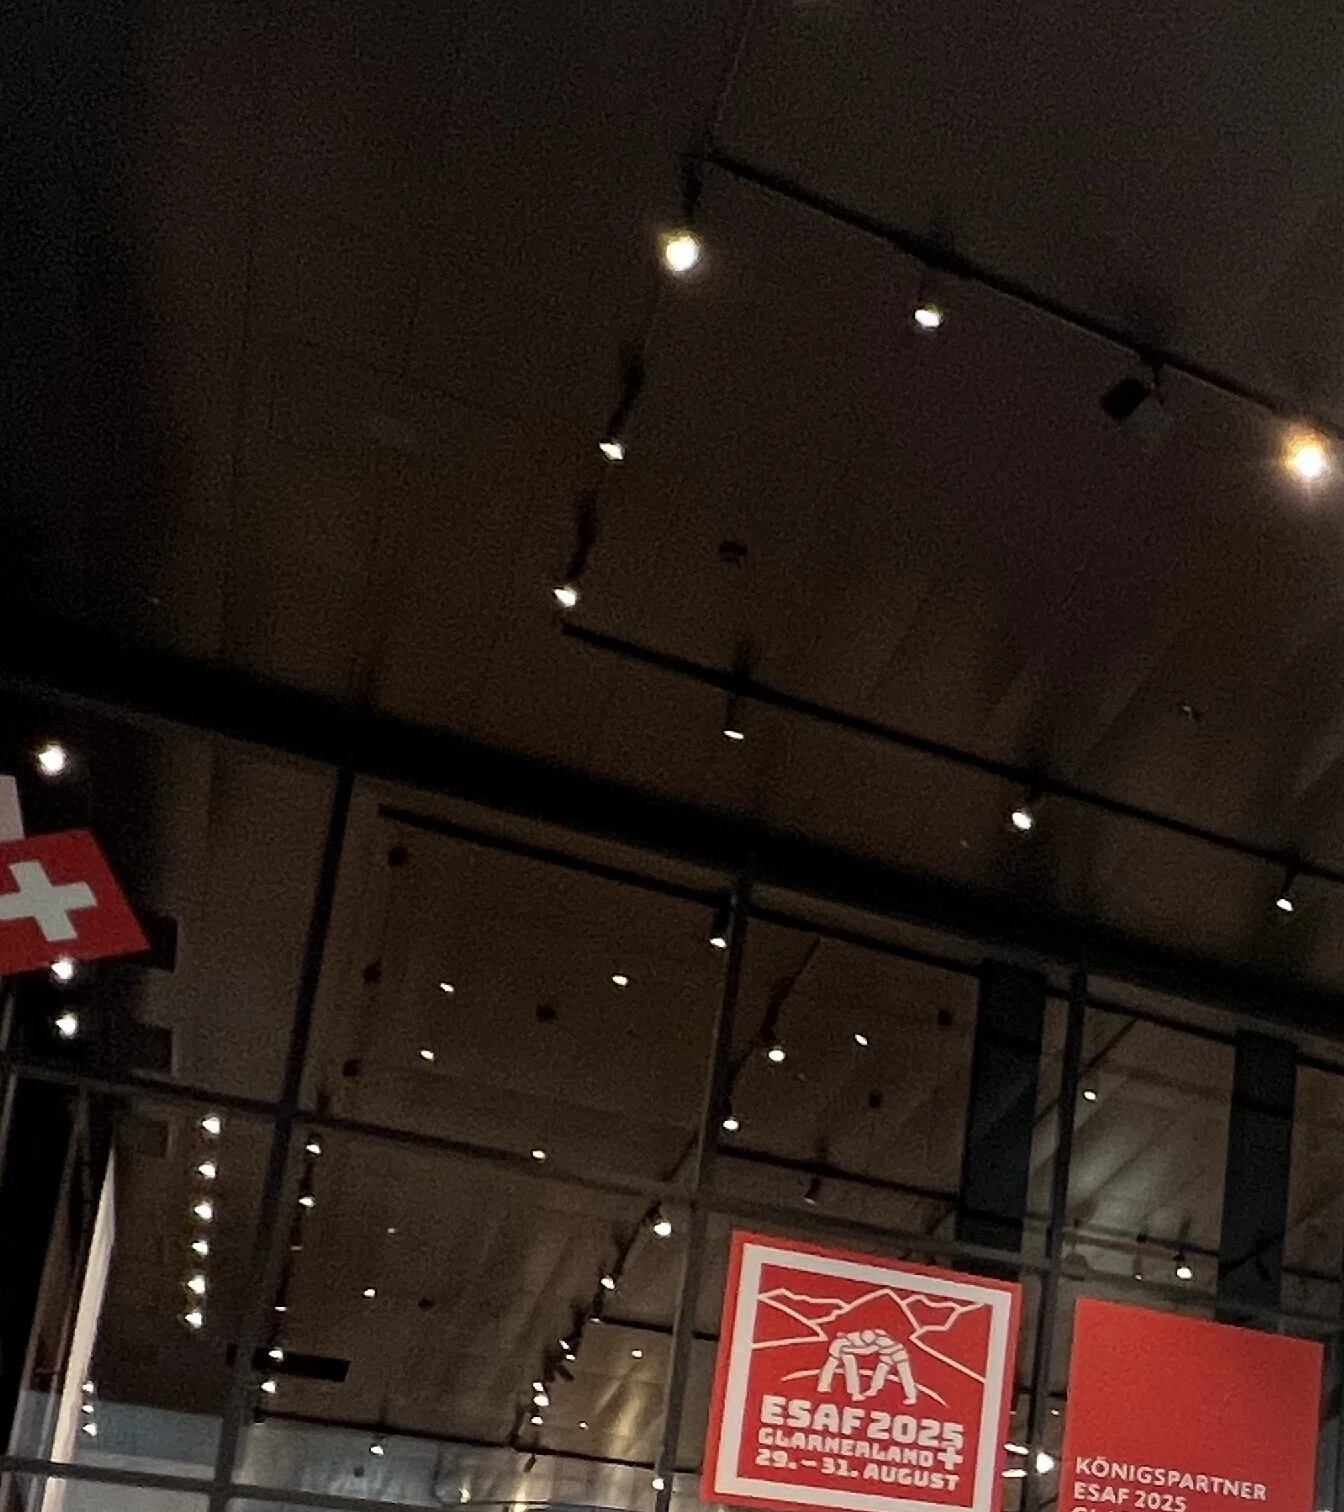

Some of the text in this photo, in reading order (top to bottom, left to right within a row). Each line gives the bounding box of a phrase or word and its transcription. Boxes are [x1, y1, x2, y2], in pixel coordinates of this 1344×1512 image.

[761, 1394, 964, 1450] ESAF 2025
[756, 1448, 797, 1470] 29.
[821, 1457, 859, 1478] 31.
[862, 1462, 960, 1491] AUGUST
[1076, 1456, 1267, 1501] KÖNIGSPARTNER
[1074, 1482, 1129, 1504] ESAF
